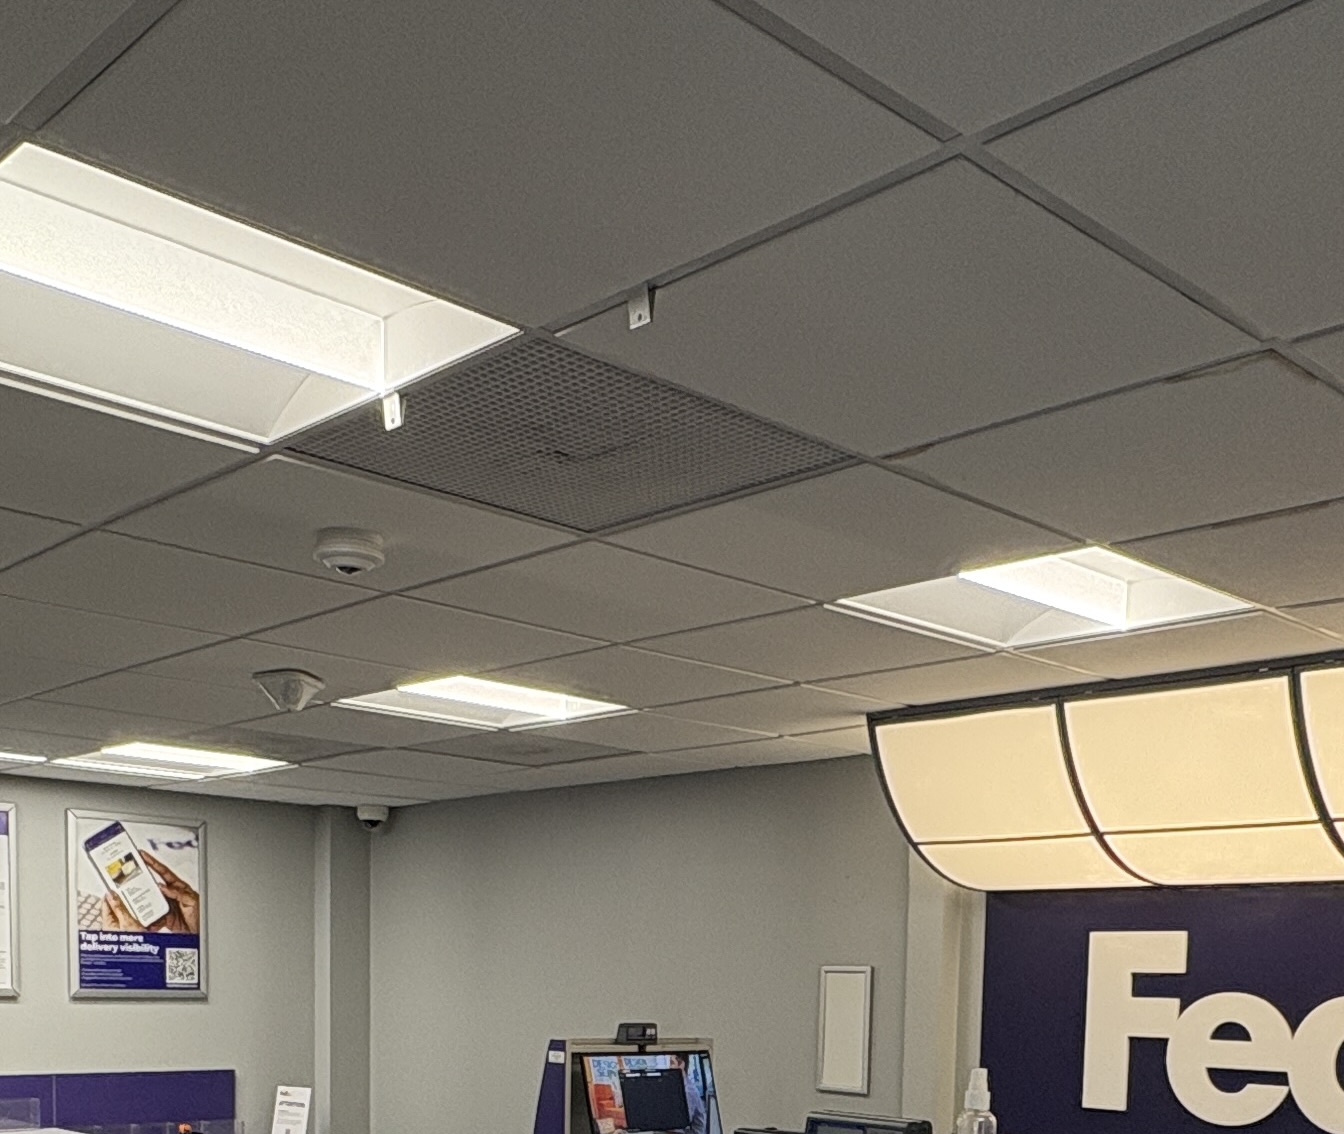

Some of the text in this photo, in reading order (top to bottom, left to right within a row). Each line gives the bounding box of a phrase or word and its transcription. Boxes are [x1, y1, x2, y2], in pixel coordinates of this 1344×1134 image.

[80, 932, 144, 943] Tap into more
[80, 942, 159, 954] delivery visibility
